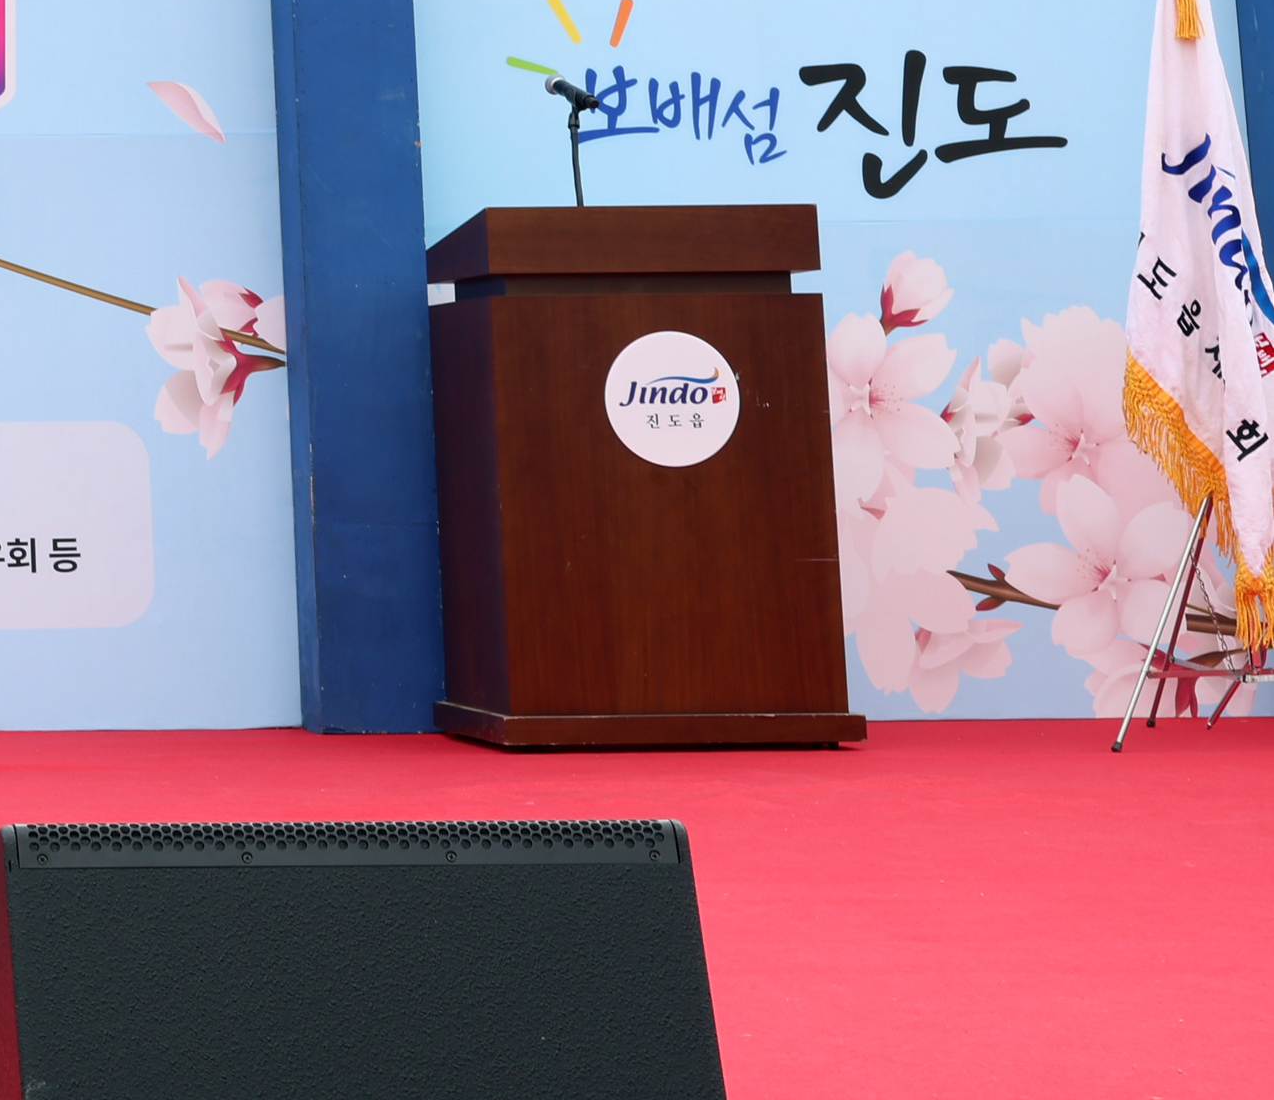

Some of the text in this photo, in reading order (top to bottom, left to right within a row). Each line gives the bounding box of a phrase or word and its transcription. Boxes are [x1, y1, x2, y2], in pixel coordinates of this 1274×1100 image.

[574, 49, 1069, 199] 보배섬 진도
[619, 381, 708, 407] Jindo
[47, 537, 83, 574] 등
